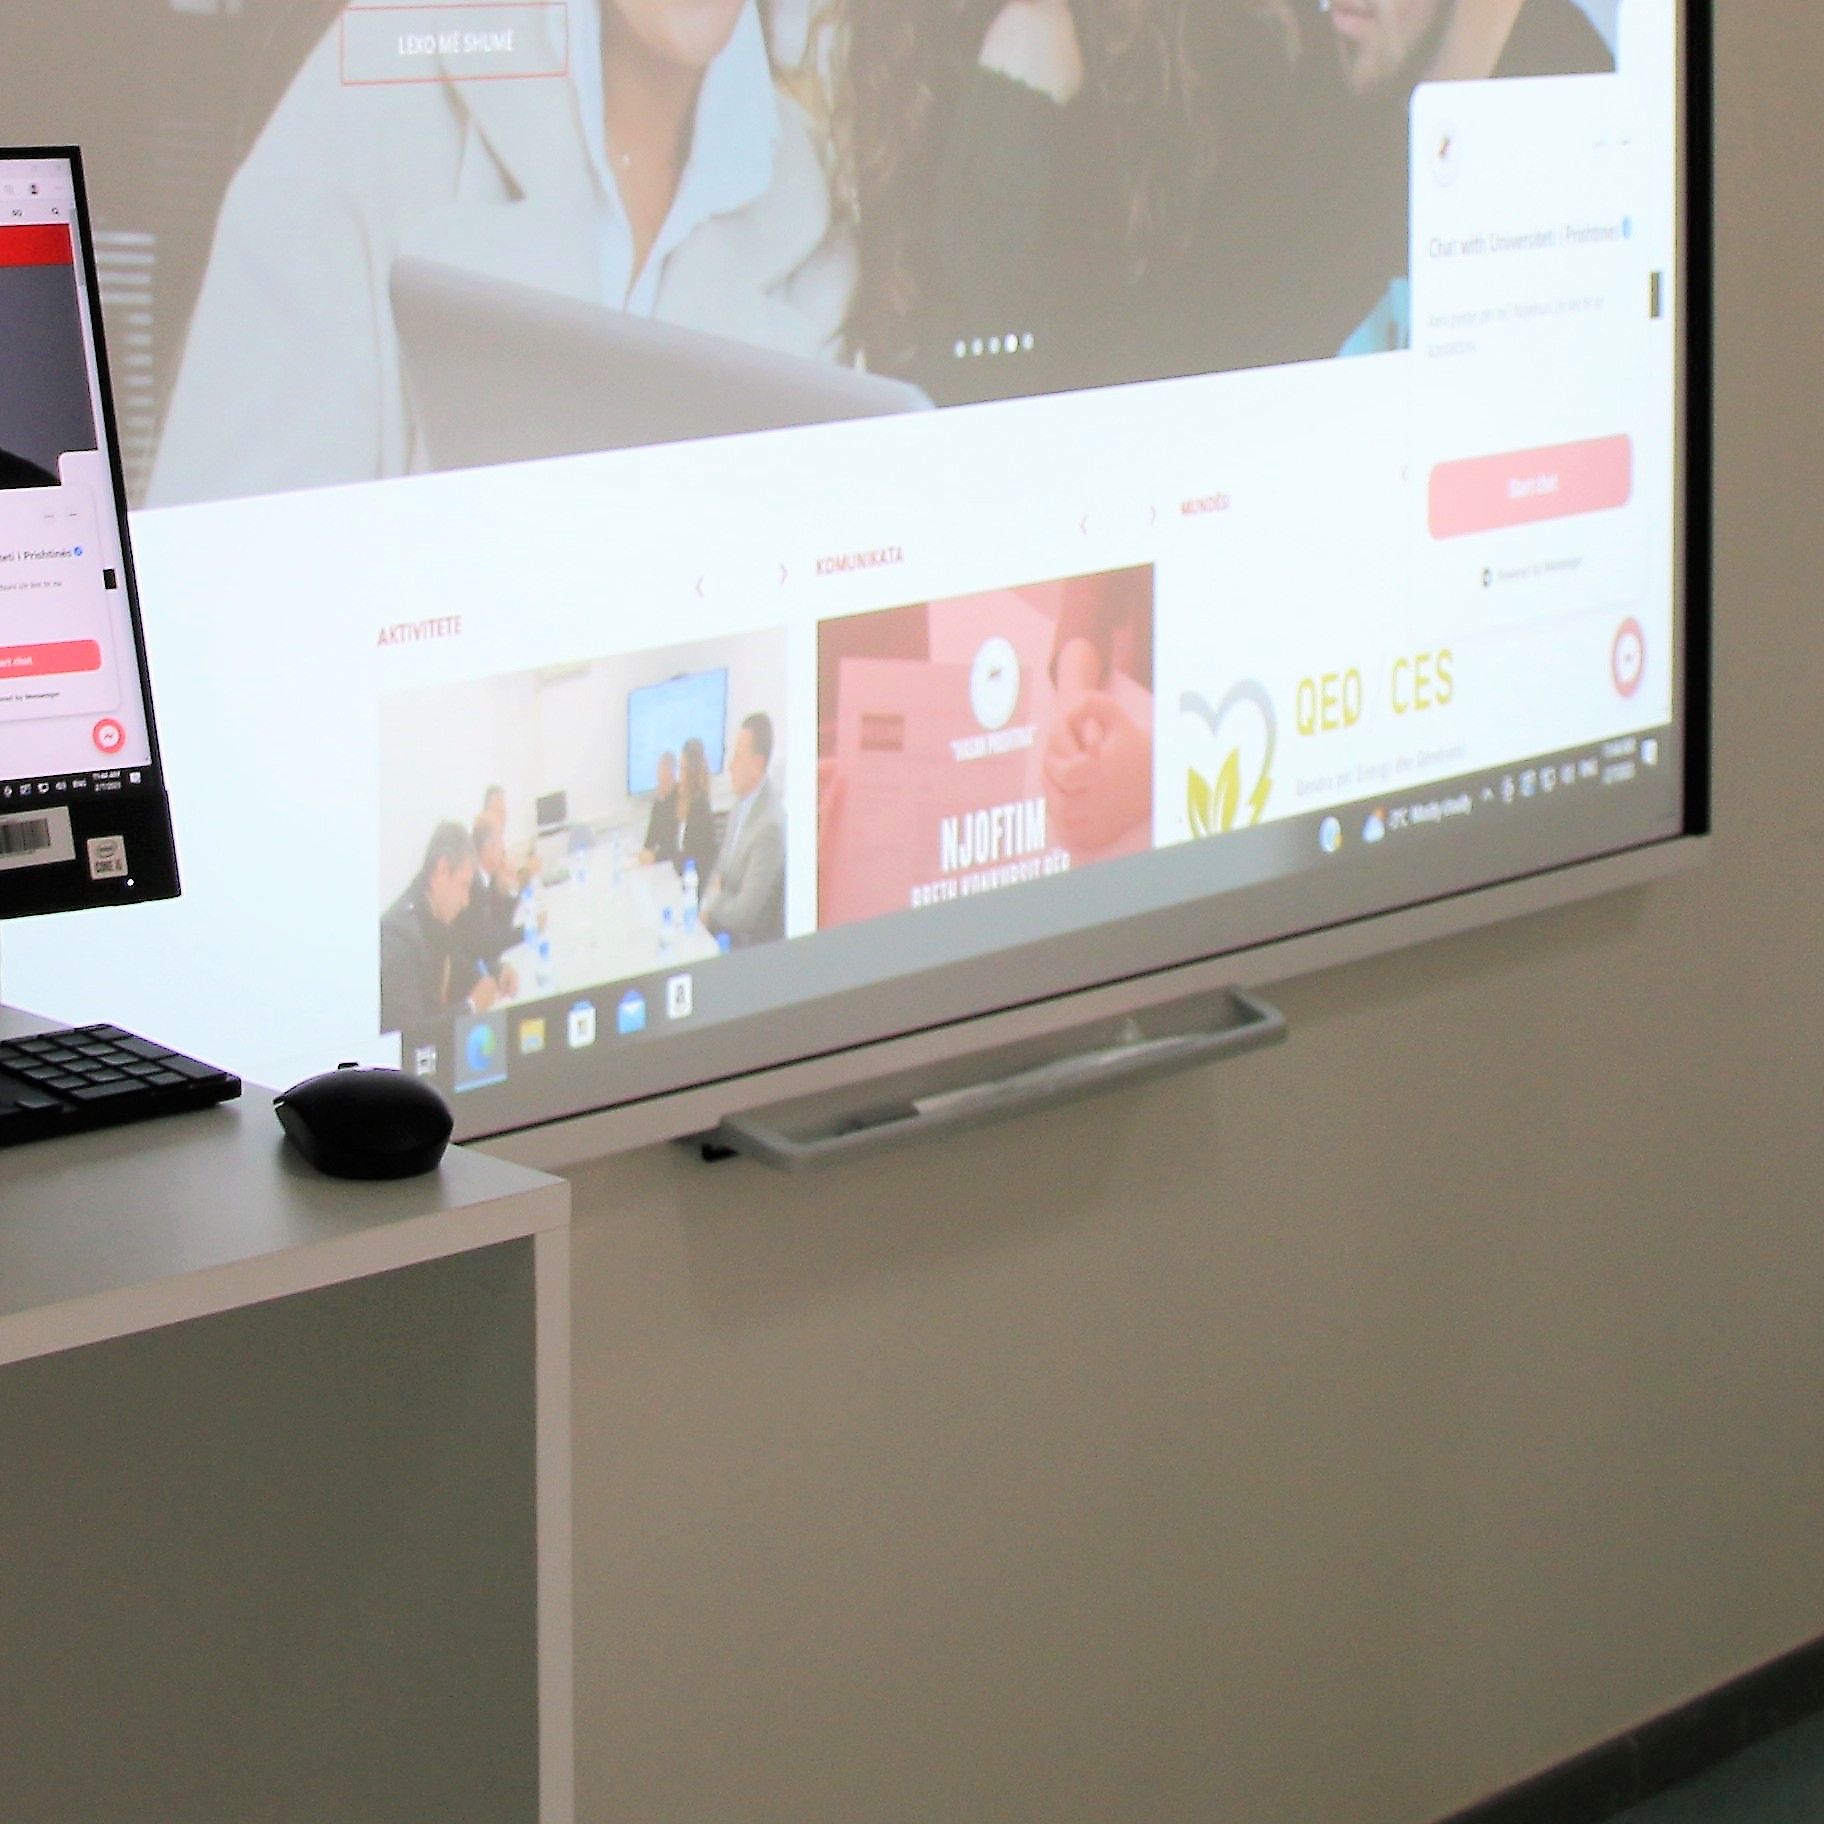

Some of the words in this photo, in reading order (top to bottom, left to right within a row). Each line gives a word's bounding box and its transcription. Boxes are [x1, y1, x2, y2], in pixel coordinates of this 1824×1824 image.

[397, 31, 436, 56] LEXO
[463, 28, 514, 53] SHUMË
[816, 546, 904, 576] KOMUNIKATA
[377, 614, 463, 647] AKTIVITETE
[1389, 649, 1456, 716] CES
[939, 795, 1047, 873] NJOFTIM
